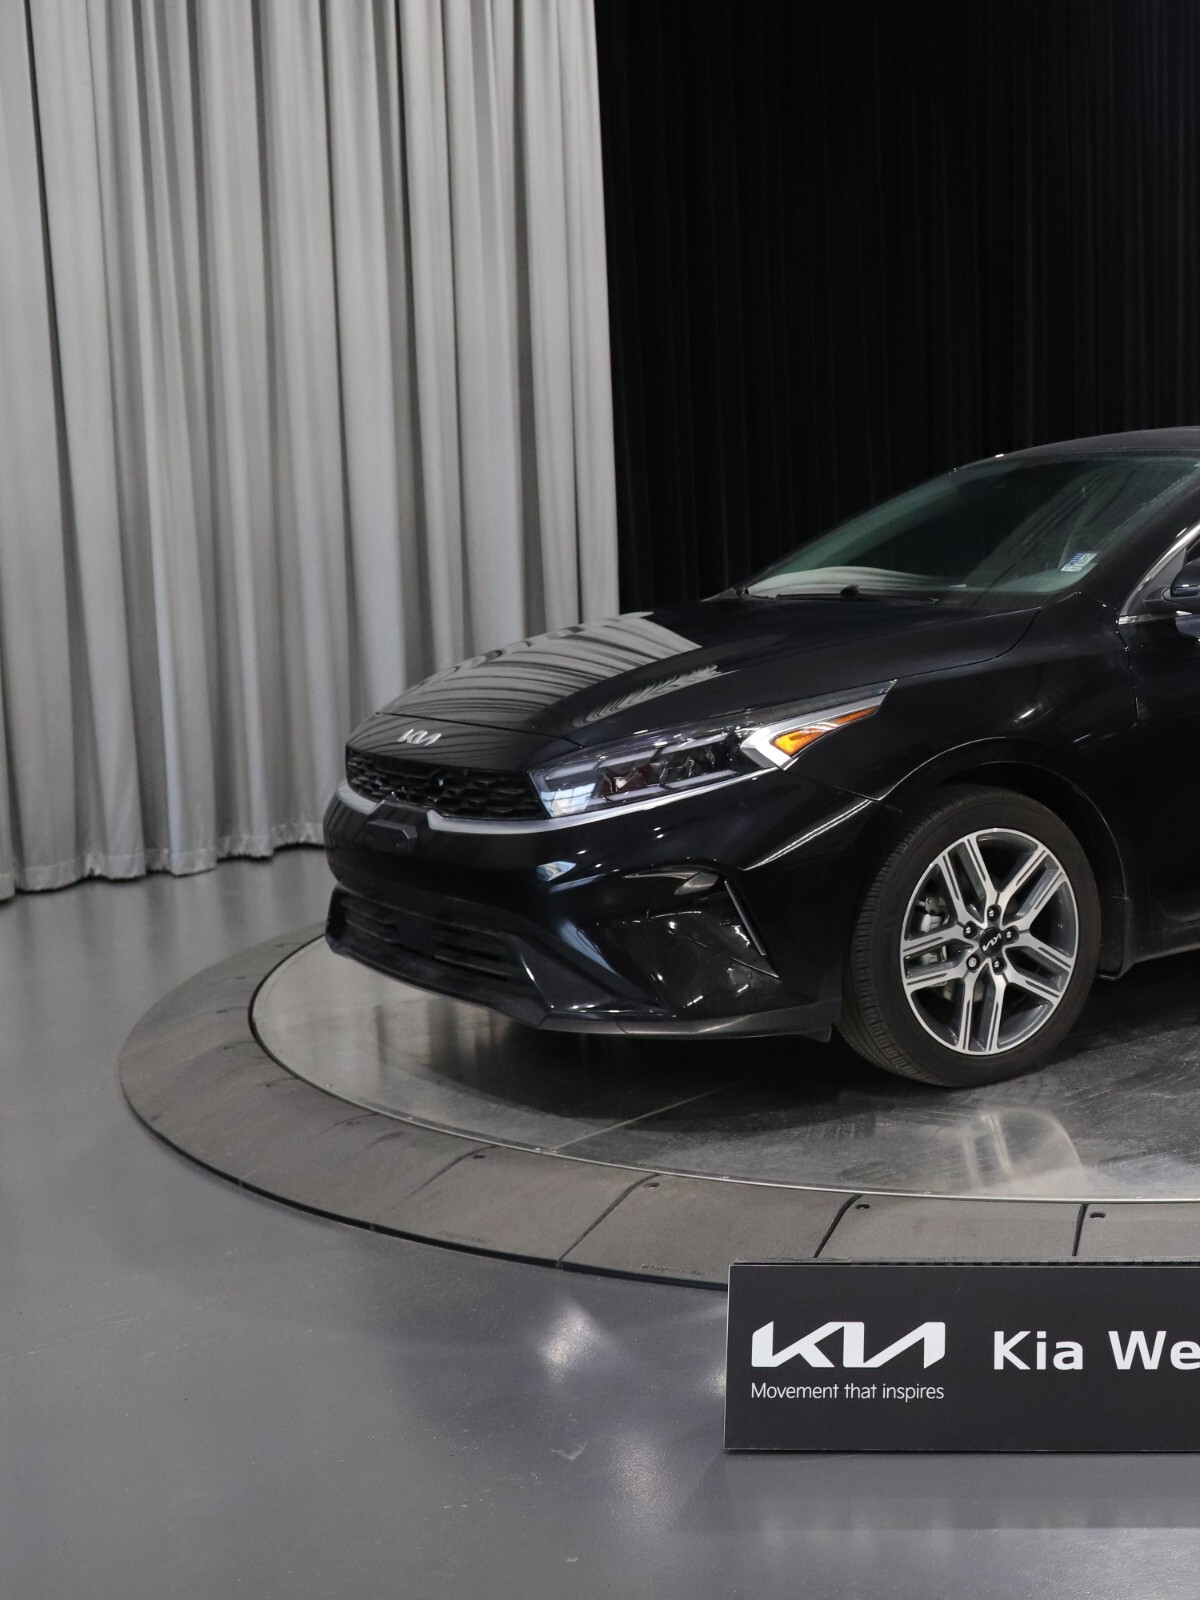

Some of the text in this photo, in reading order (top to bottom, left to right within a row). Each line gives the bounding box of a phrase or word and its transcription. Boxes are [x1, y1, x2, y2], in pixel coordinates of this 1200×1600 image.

[397, 729, 442, 747] KIA
[751, 1320, 946, 1370] KIA
[993, 1330, 1084, 1371] Kia
[751, 1382, 945, 1403] Movement that inspires
